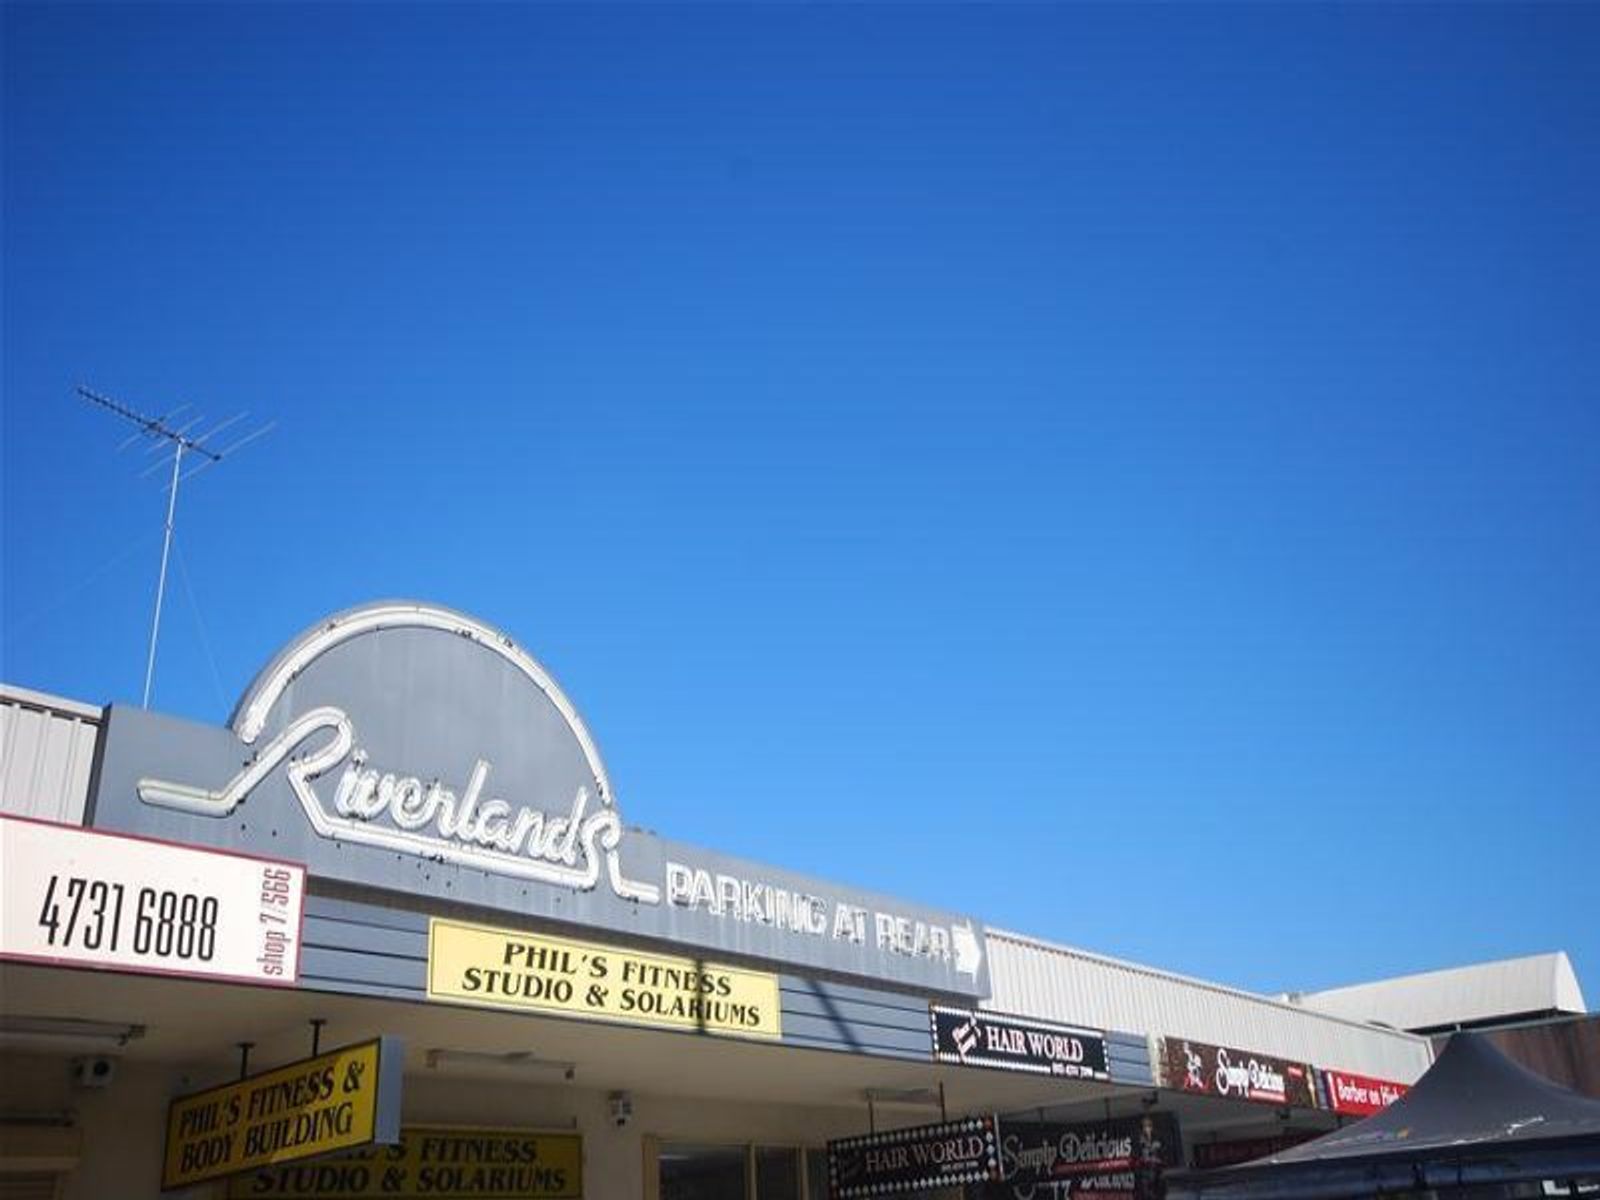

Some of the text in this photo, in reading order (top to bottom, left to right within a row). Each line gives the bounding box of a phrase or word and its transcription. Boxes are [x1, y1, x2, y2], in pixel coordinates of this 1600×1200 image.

[38, 875, 219, 962] 4731 6888
[665, 862, 950, 962] PARKING AT REAR
[256, 930, 292, 977] shop
[503, 942, 732, 997] PHIL'S FITNESS
[461, 967, 761, 1027] STUDIO & SOLARIUMS
[985, 1025, 1084, 1063] HAIR WORLD
[179, 1060, 366, 1139] PHIL'S FITNESS &
[180, 1133, 238, 1174] BODY
[242, 1101, 354, 1160] BUILDING
[420, 1137, 539, 1164] FITNESS
[865, 1149, 911, 1173] HAIR
[911, 1135, 984, 1168] WORLD
[252, 1166, 566, 1193] STUDIO & SOLARIUMS
